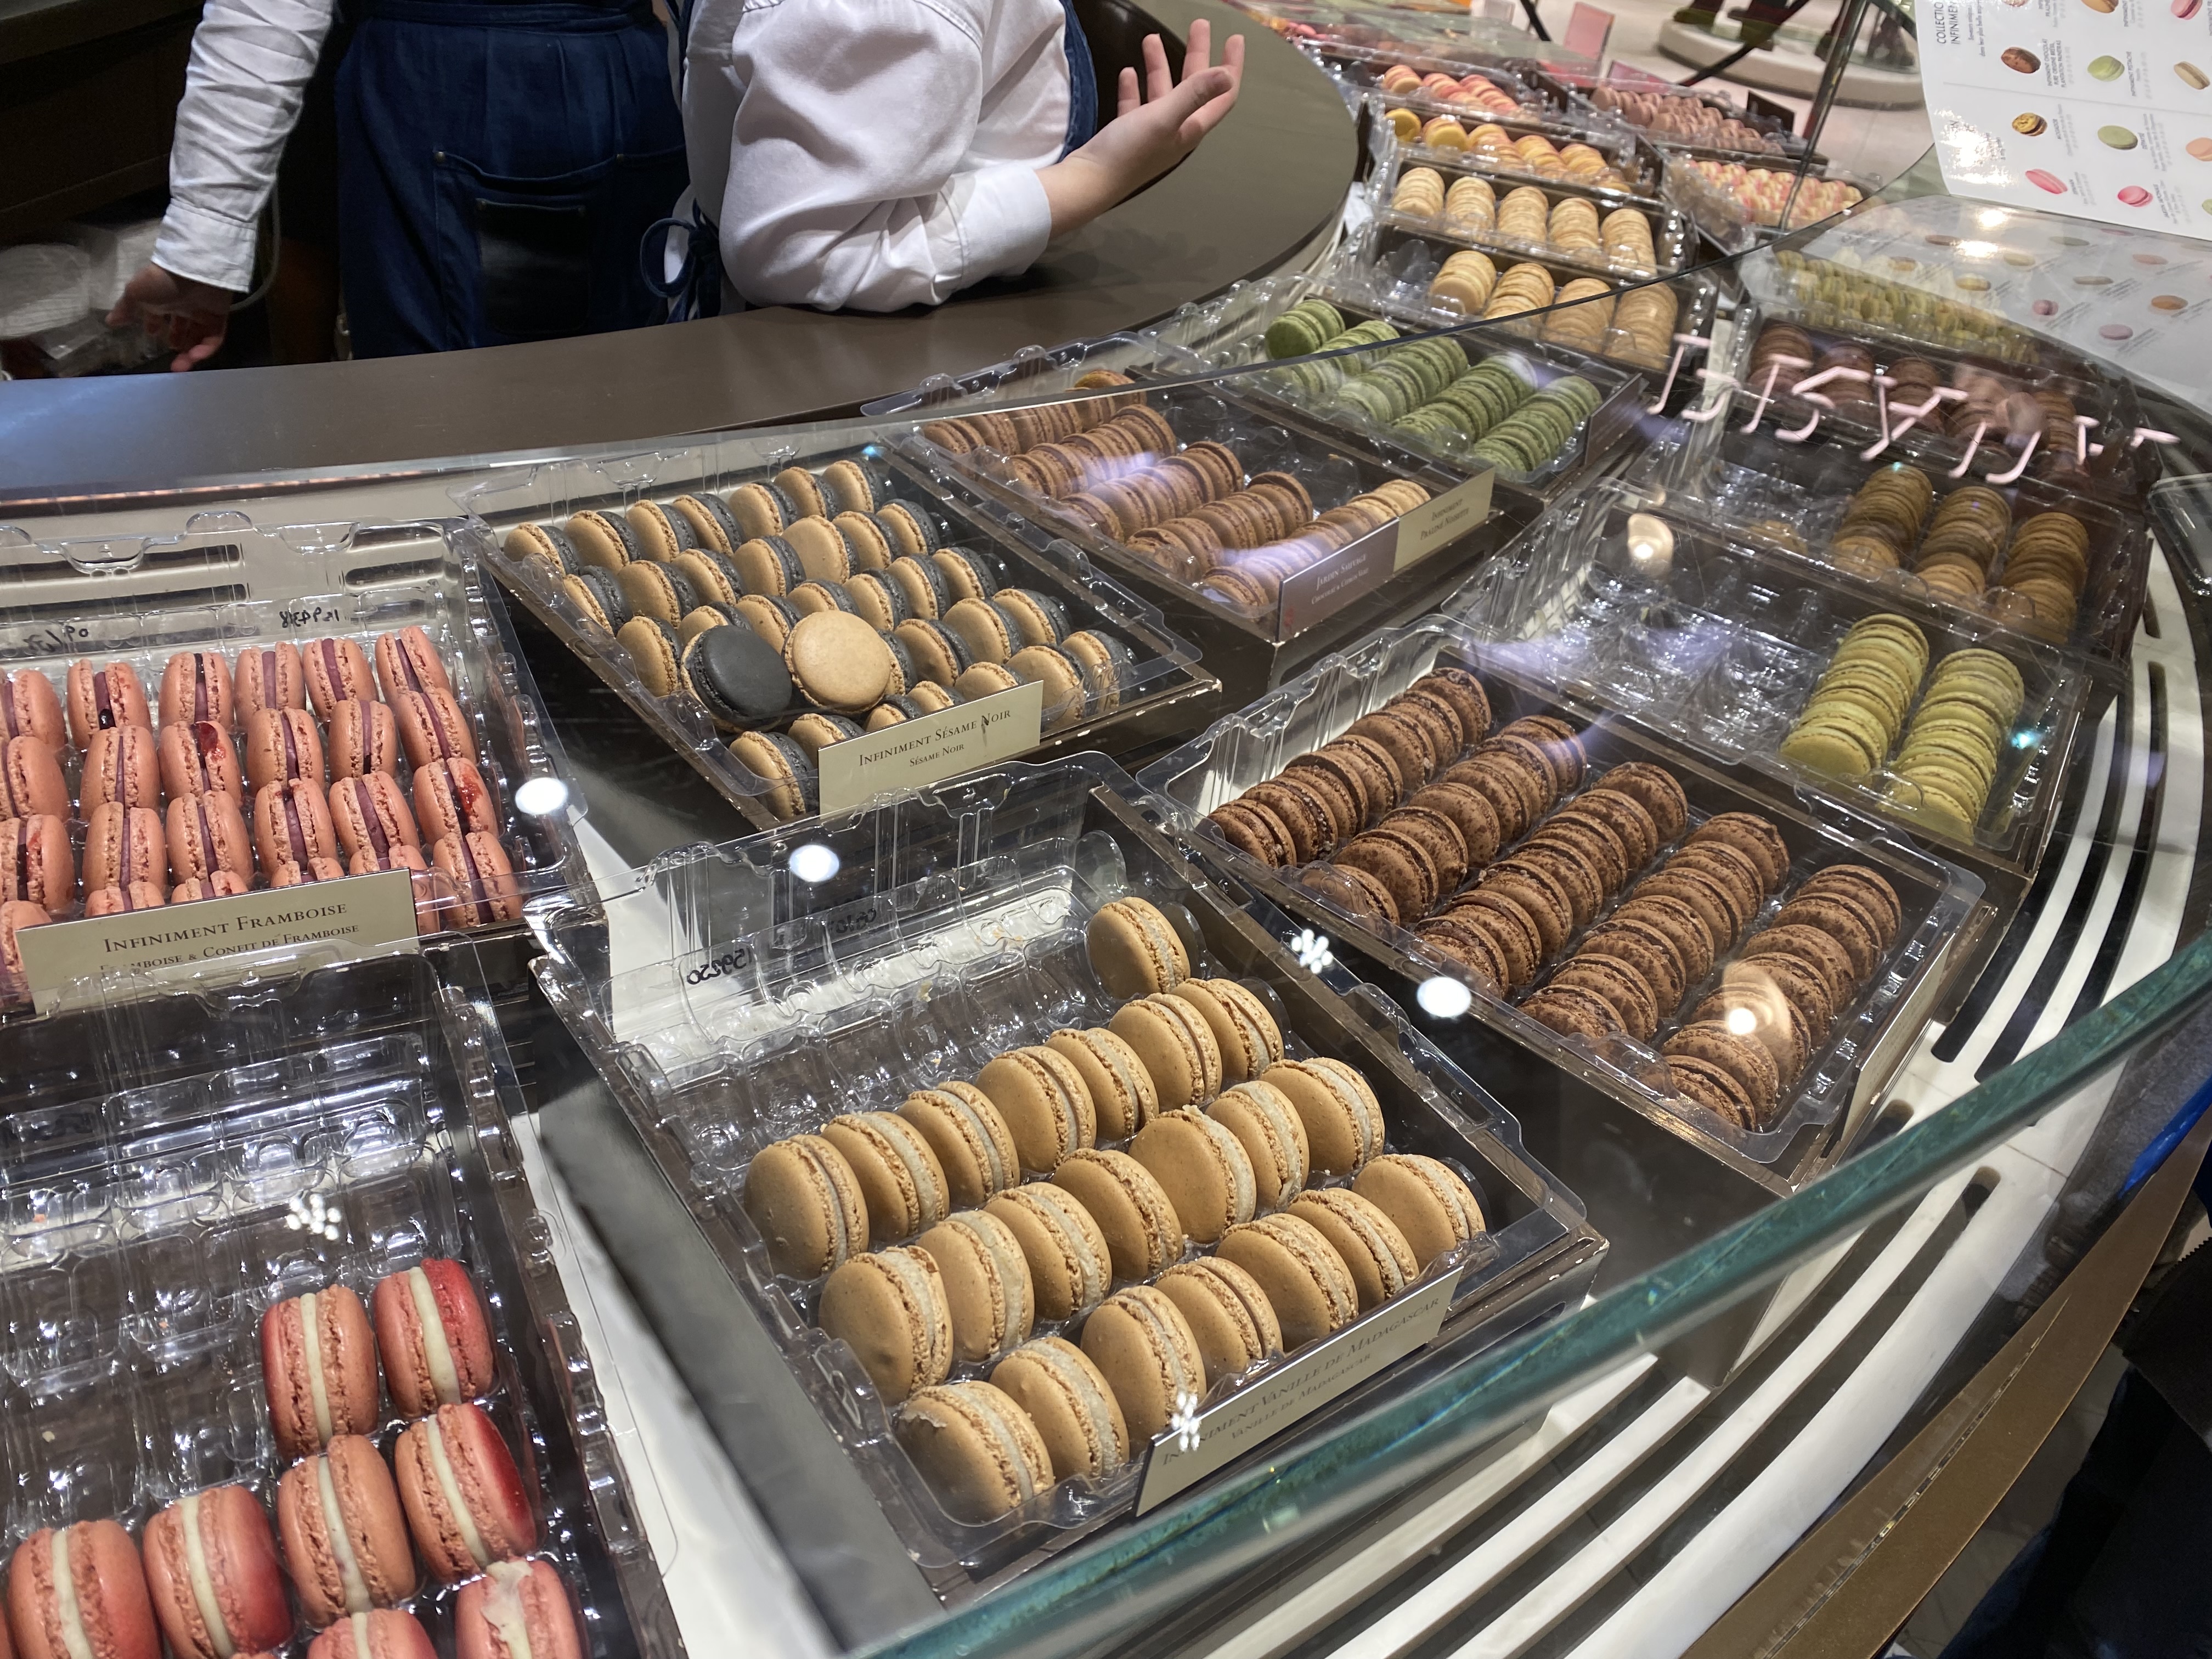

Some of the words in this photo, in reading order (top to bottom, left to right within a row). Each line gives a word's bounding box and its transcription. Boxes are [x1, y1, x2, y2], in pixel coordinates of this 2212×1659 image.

[1934, 1, 1947, 44] COLLECTIO
[1948, 1, 1961, 45] INFINIMEN
[860, 735, 932, 766] INFINIMENT
[934, 720, 978, 741] SÉSAME
[980, 710, 1011, 727] NOIR
[909, 751, 940, 767] SÉSAME
[942, 744, 964, 757] NOIR
[99, 955, 183, 975] FMBOISE
[203, 941, 257, 958] CONFIT
[283, 925, 360, 944] FRAMBOISE
[103, 923, 230, 953] INFINIMENT
[235, 904, 347, 931] FRAMBOISE
[1163, 1402, 1259, 1465] INNIMENT
[1261, 1366, 1322, 1406] VANILLE
[1323, 1352, 1345, 1371] DE
[1346, 1298, 1439, 1357] MADAGASCAR
